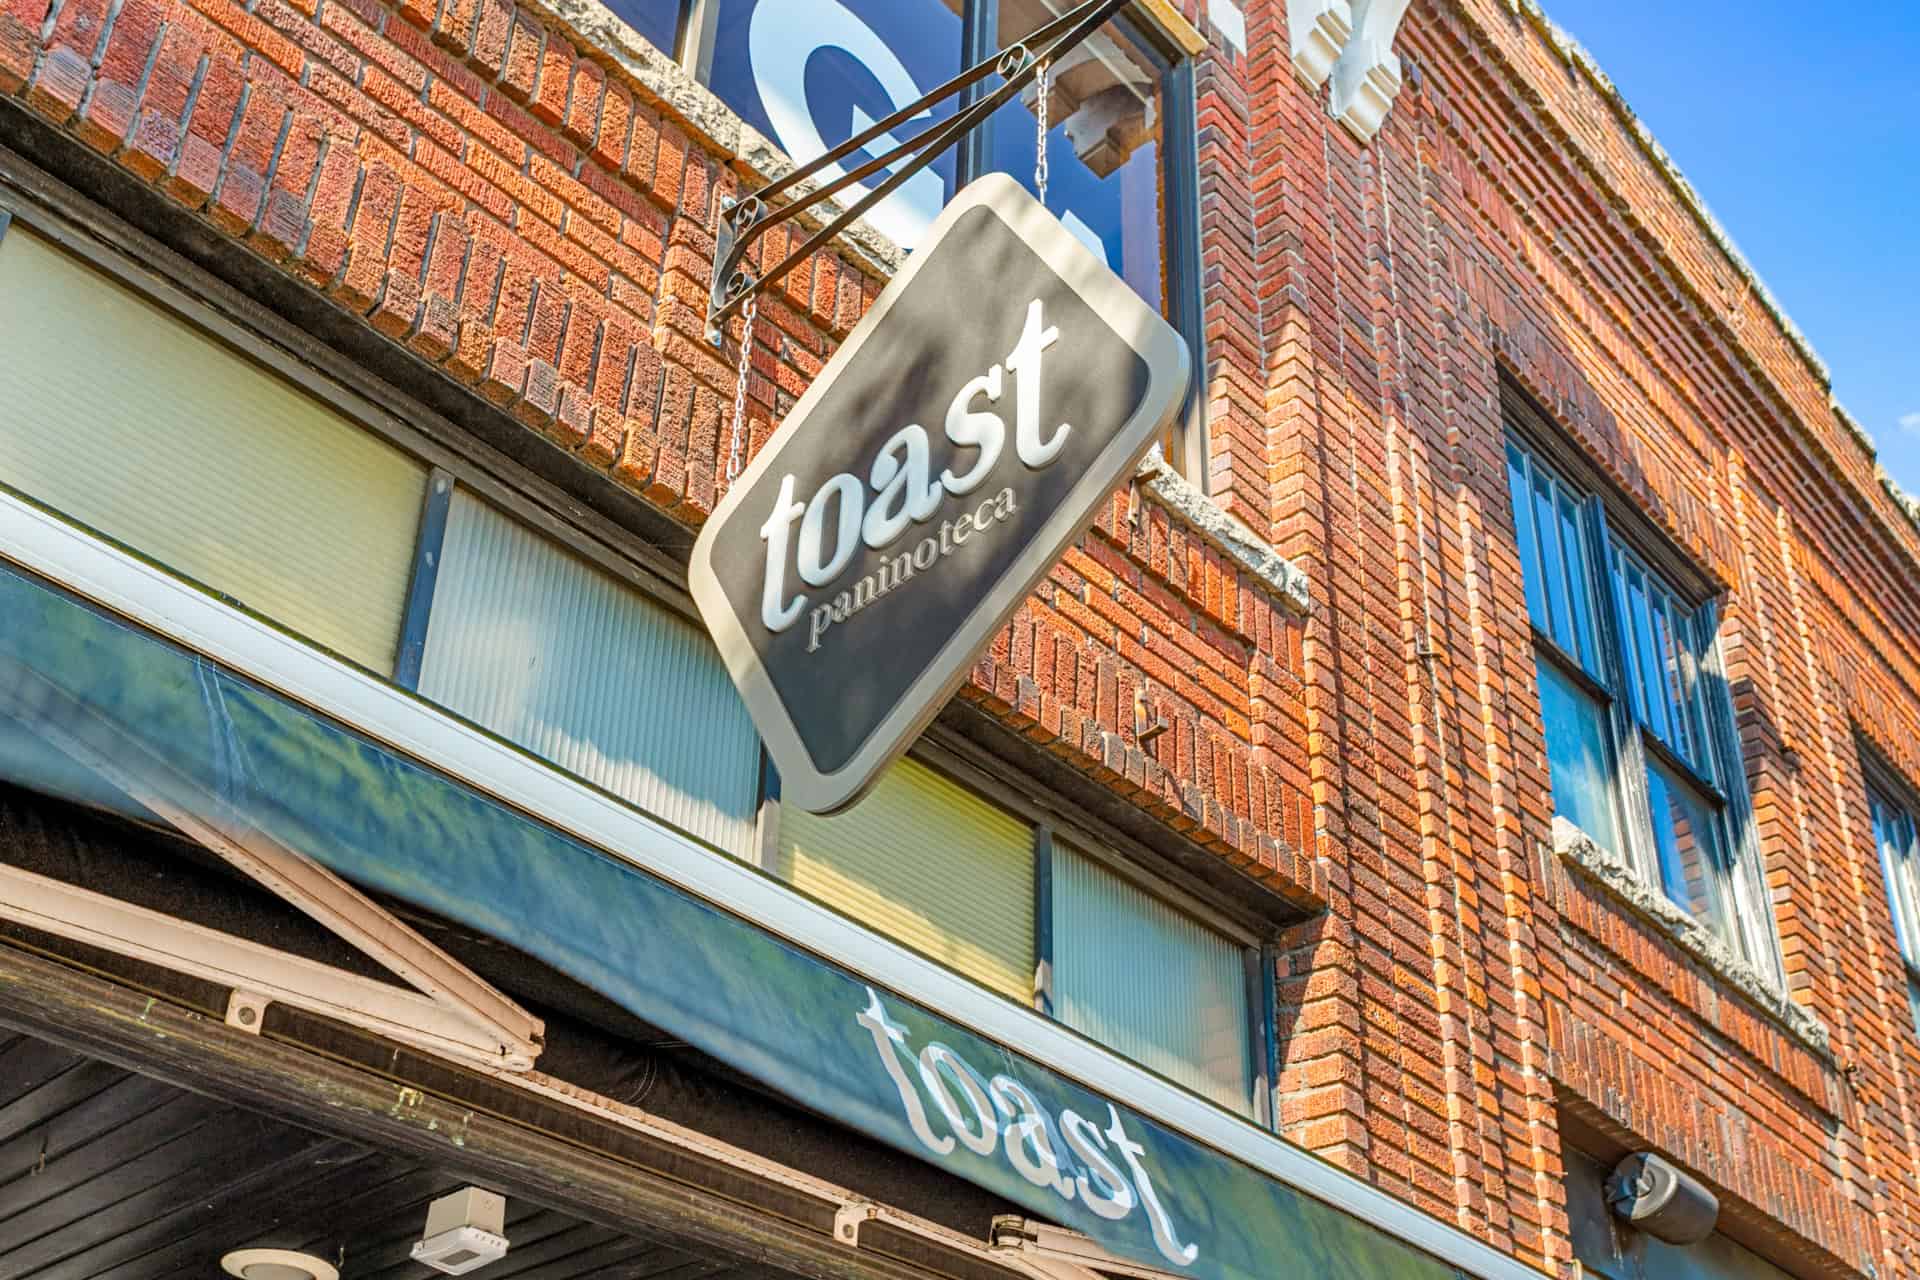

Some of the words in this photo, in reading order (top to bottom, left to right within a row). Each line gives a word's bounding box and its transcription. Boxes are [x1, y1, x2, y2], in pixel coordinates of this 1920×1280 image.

[760, 298, 1072, 634] toast
[806, 487, 1018, 653] paninoteca
[856, 986, 1199, 1266] toast
